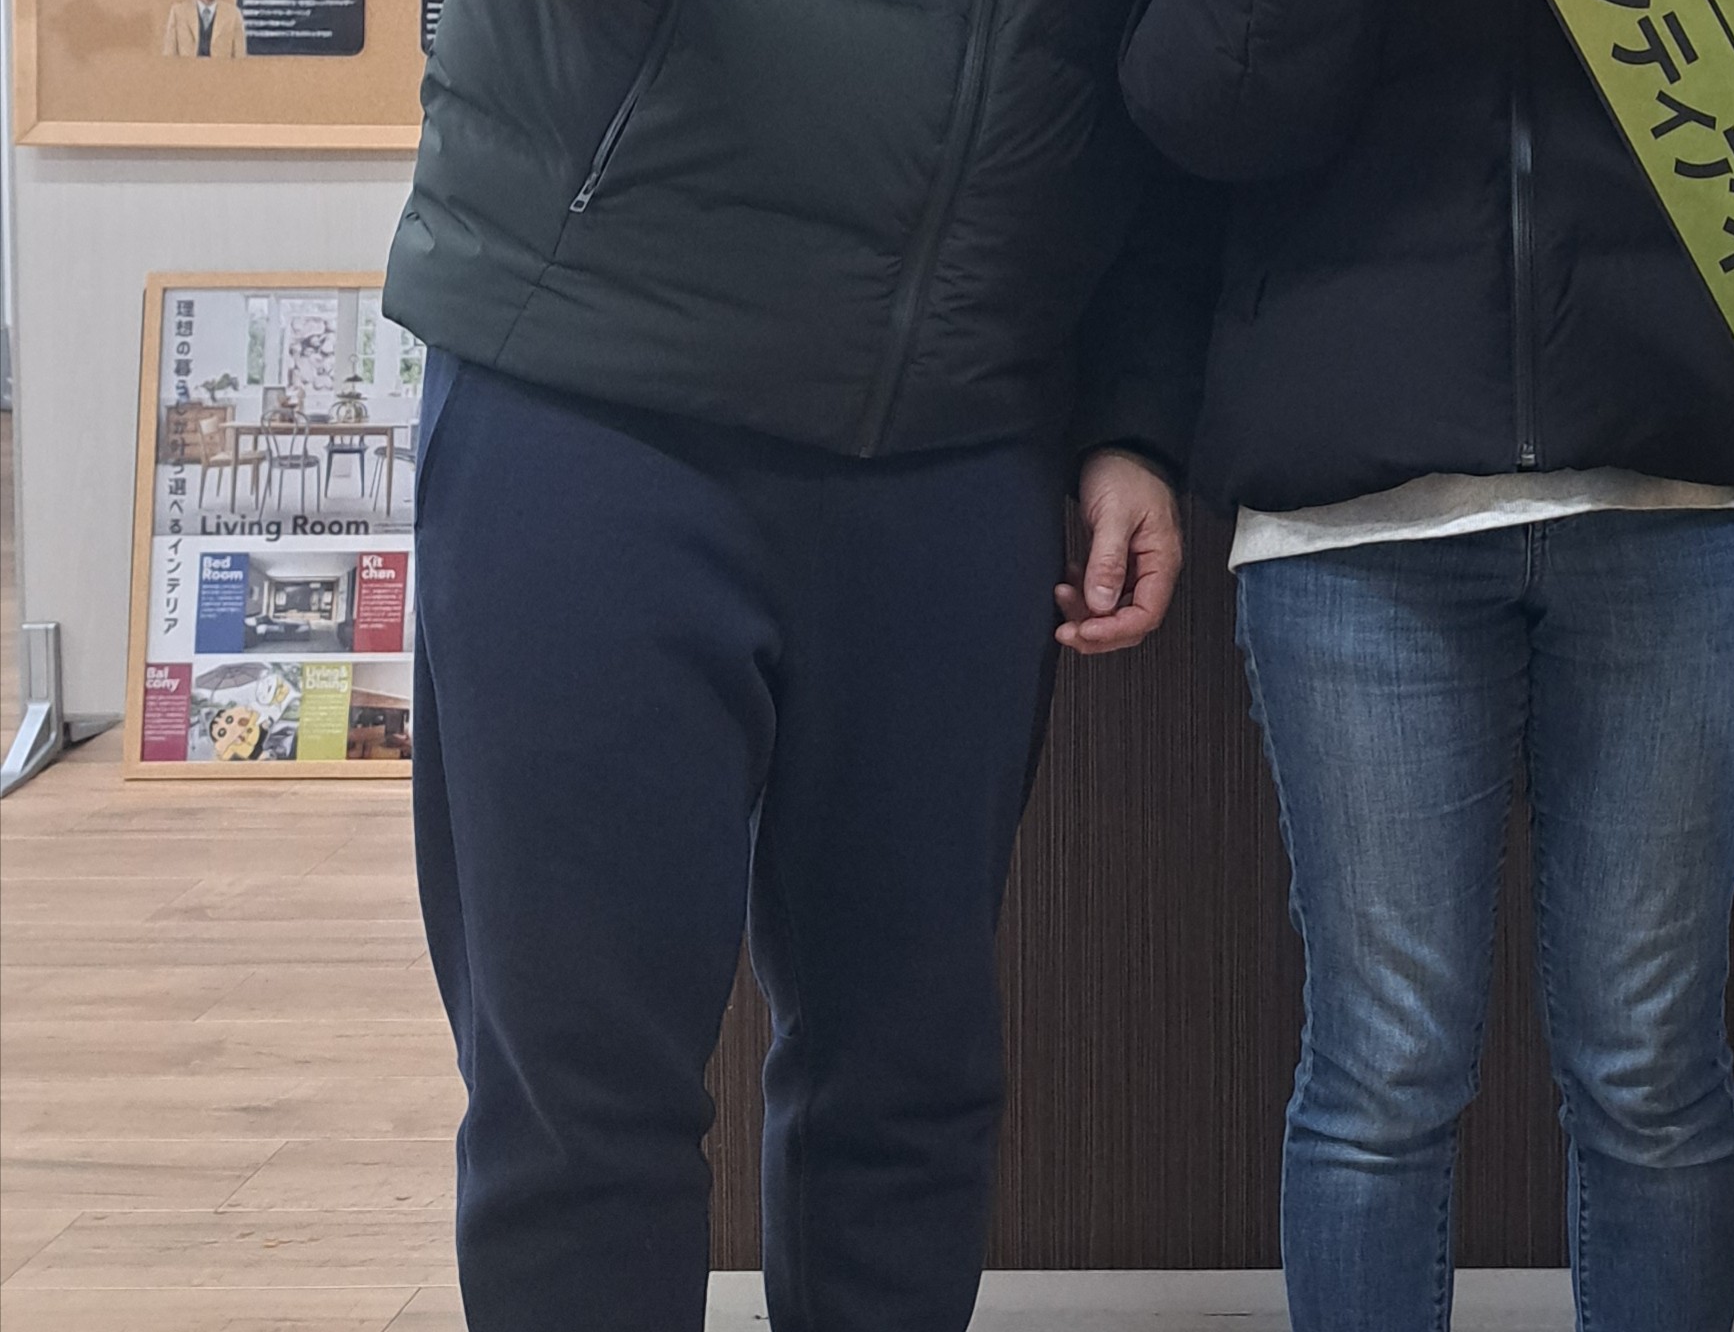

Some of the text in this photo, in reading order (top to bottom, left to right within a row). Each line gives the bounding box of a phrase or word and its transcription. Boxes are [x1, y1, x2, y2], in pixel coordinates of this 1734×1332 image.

[200, 515, 282, 542] Living
[292, 515, 370, 536] Room
[202, 556, 232, 569] Bed
[361, 555, 384, 568] Kit
[201, 569, 243, 581] Room
[146, 667, 170, 679] Bal
[304, 678, 349, 693] Dining
